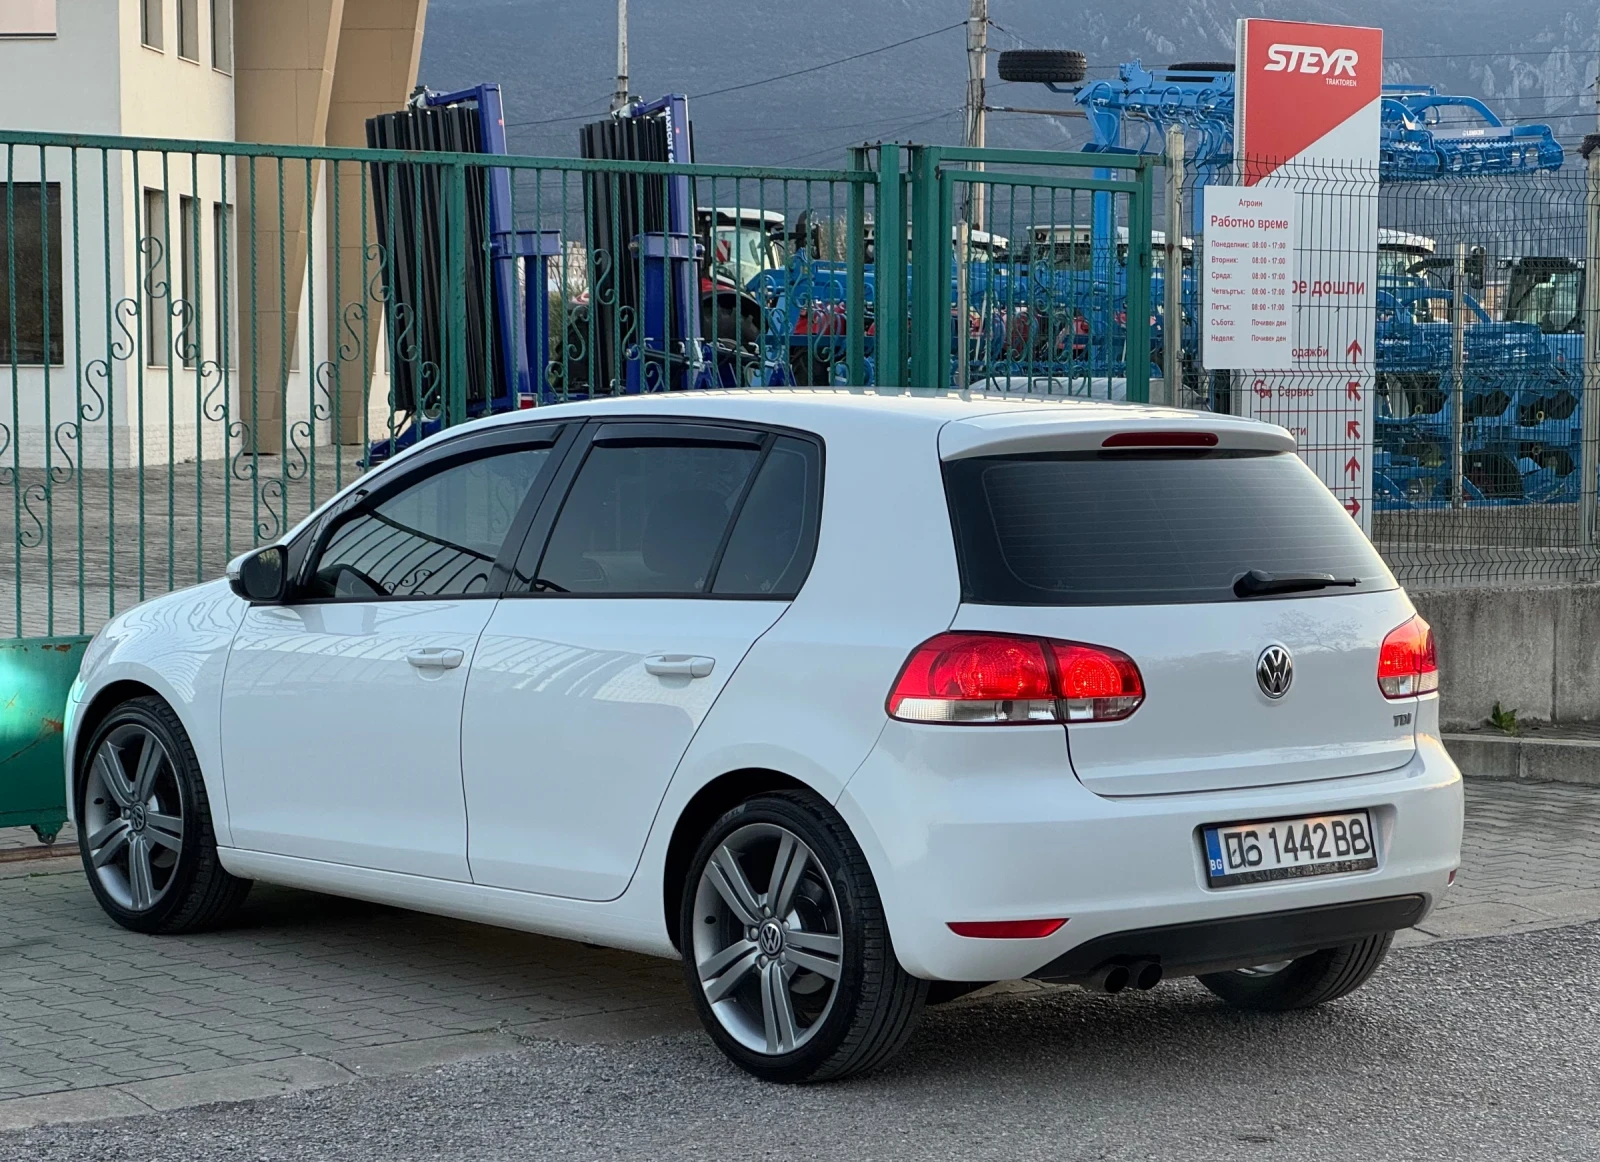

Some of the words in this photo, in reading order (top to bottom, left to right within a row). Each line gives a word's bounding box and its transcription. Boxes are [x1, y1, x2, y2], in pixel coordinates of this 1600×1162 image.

[1263, 43, 1359, 77] STEYR
[1325, 78, 1357, 87] TRAKTOREN
[664, 106, 674, 151] MAXICUT
[1238, 198, 1263, 208] Агроин
[1210, 214, 1255, 228] Работно
[1257, 219, 1289, 231] време
[1211, 240, 1250, 249] Понеделник:
[1272, 241, 1286, 249] 17:00
[1211, 256, 1239, 264] Вторник:
[1211, 271, 1232, 280] Сряда:
[1211, 287, 1246, 296] Четвъртък:
[1271, 288, 1285, 296] 17:00
[1312, 280, 1365, 297] дошли
[1211, 303, 1232, 311] Петък:
[1271, 303, 1285, 311] 17:00
[1211, 318, 1236, 326] Събота:
[1252, 319, 1275, 327] Почивен
[1211, 334, 1235, 342] Неделя:
[1292, 345, 1329, 359] одажби
[1278, 386, 1314, 399] Сервиз
[1393, 712, 1412, 727] TDI
[1269, 822, 1331, 864] 1442
[1211, 859, 1223, 870] BG
